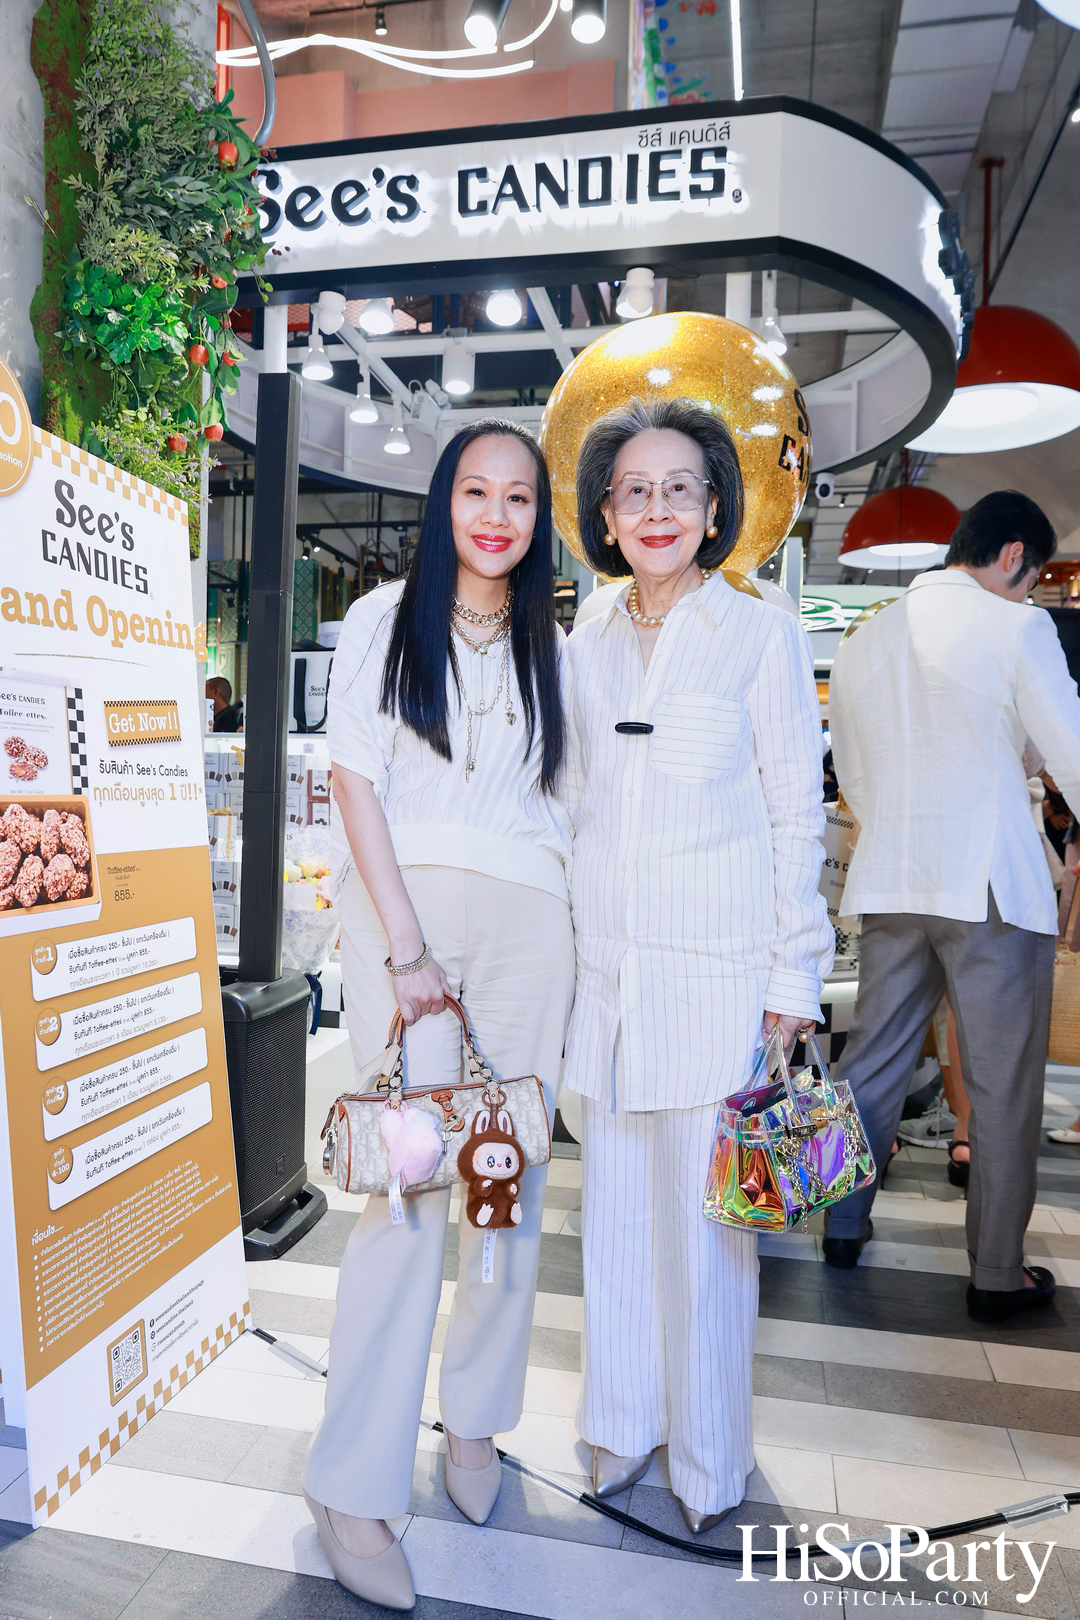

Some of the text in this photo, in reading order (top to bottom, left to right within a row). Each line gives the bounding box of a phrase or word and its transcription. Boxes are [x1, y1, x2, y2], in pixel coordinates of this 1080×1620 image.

[638, 120, 731, 148] ซีส์ แคนดีส์
[458, 146, 728, 218] CANDIES
[54, 479, 135, 552] See's
[41, 529, 149, 595] CANDIES
[0, 586, 208, 662] and Opening
[0, 692, 46, 705] ee's CANDIES
[108, 711, 178, 734] Get Now!!
[99, 758, 188, 777] รับสินค้า See's Candies
[93, 782, 165, 807] ทุกเดือนสูงสุด
[169, 783, 177, 801] 1
[822, 858, 840, 870] e's
